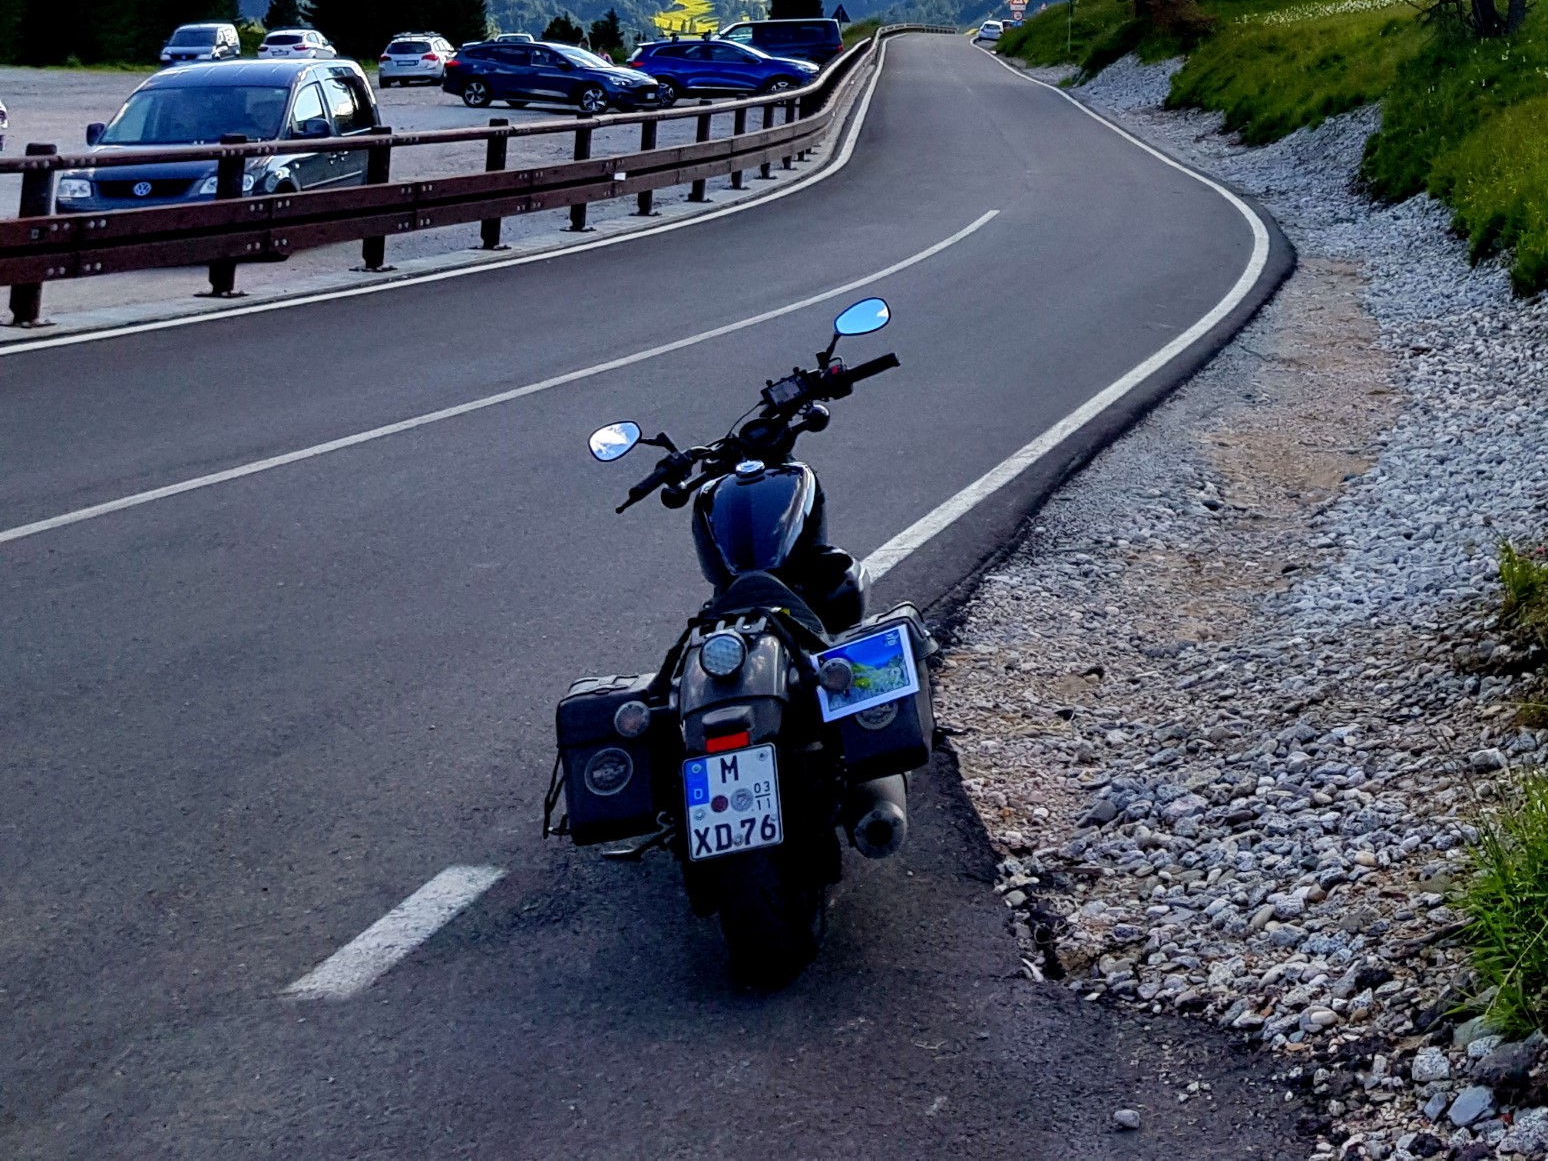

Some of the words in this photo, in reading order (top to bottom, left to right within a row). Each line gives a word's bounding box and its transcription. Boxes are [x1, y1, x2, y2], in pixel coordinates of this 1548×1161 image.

[720, 755, 739, 784] M
[754, 781, 771, 793] 03
[694, 788, 703, 799] D
